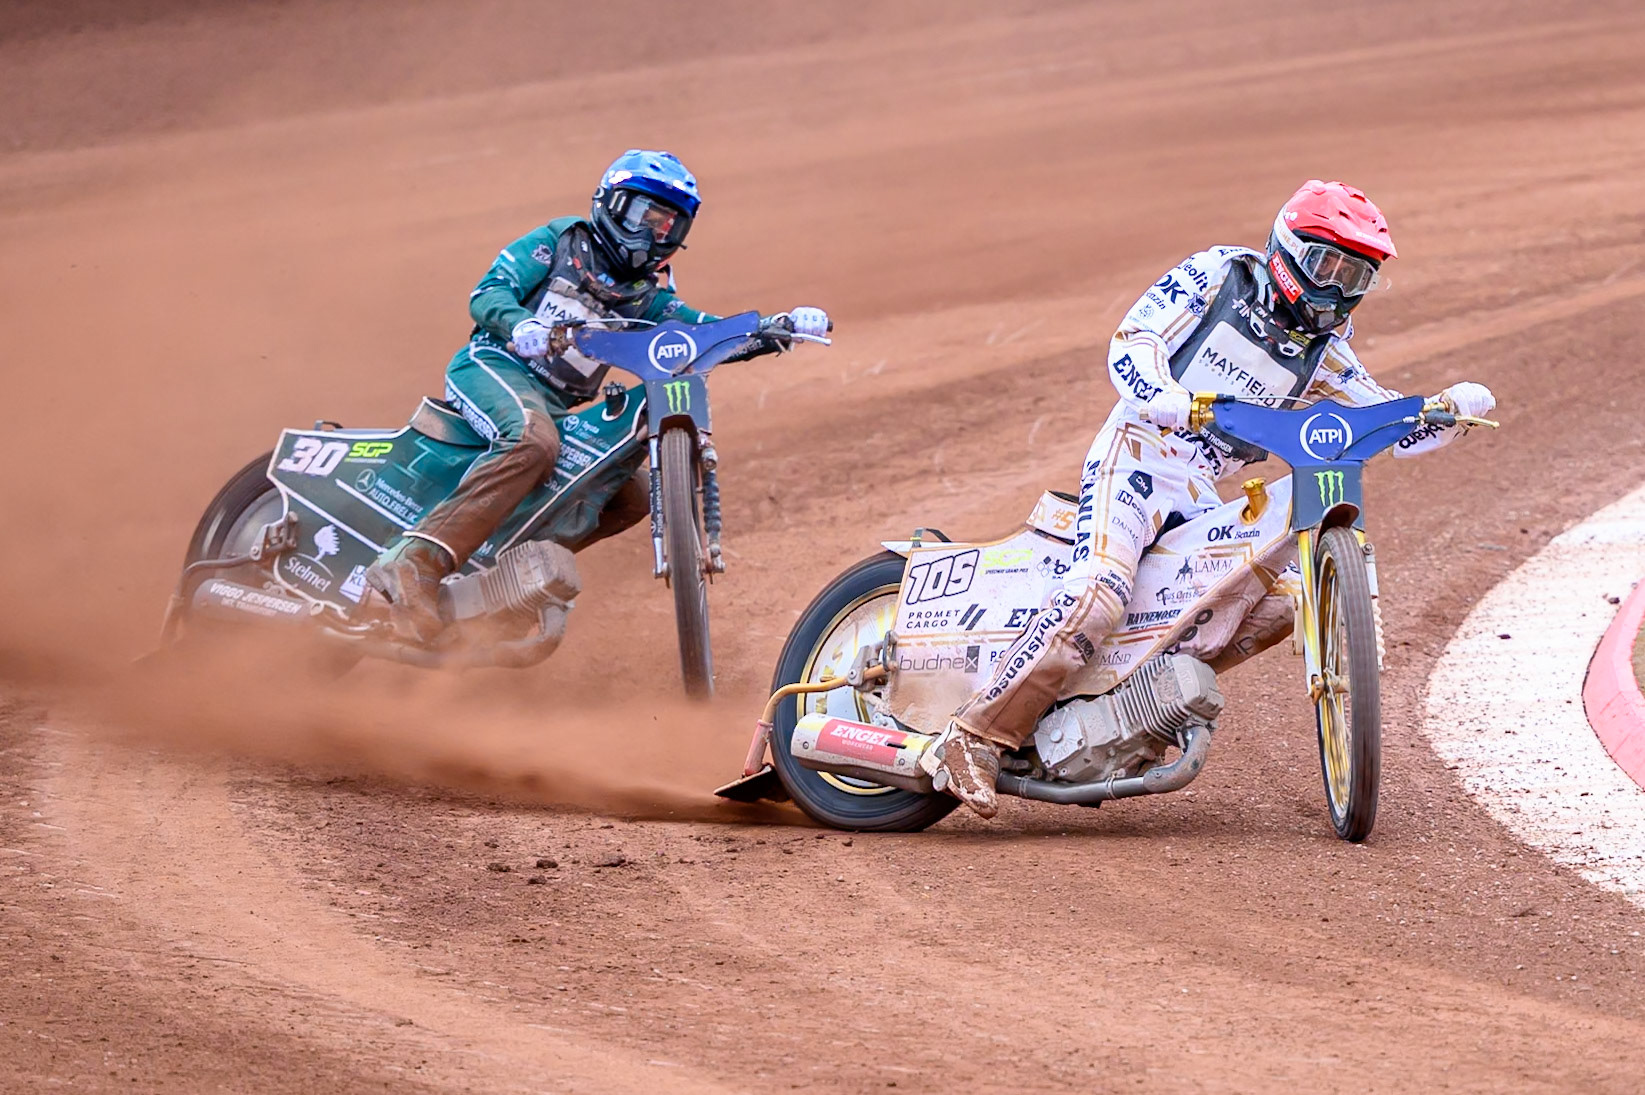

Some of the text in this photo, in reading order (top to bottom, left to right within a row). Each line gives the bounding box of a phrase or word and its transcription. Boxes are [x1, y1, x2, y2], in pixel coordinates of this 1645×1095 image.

[1178, 256, 1209, 292] eolit
[1272, 255, 1299, 296] ENGEL
[656, 343, 688, 360] ATPI
[1201, 346, 1278, 407] MAYFIELD
[348, 442, 394, 458] SGP
[1308, 428, 1343, 445] ATPI
[277, 436, 349, 477] 30
[1207, 525, 1261, 542] OK Benzin
[283, 556, 332, 593] Stelmet
[906, 548, 981, 606] 105
[209, 582, 244, 600] VIGGO
[242, 591, 302, 615] JESPERSEN
[906, 619, 949, 629] CARGO
[908, 609, 961, 619] PROMET
[830, 724, 893, 747] ENGEL
